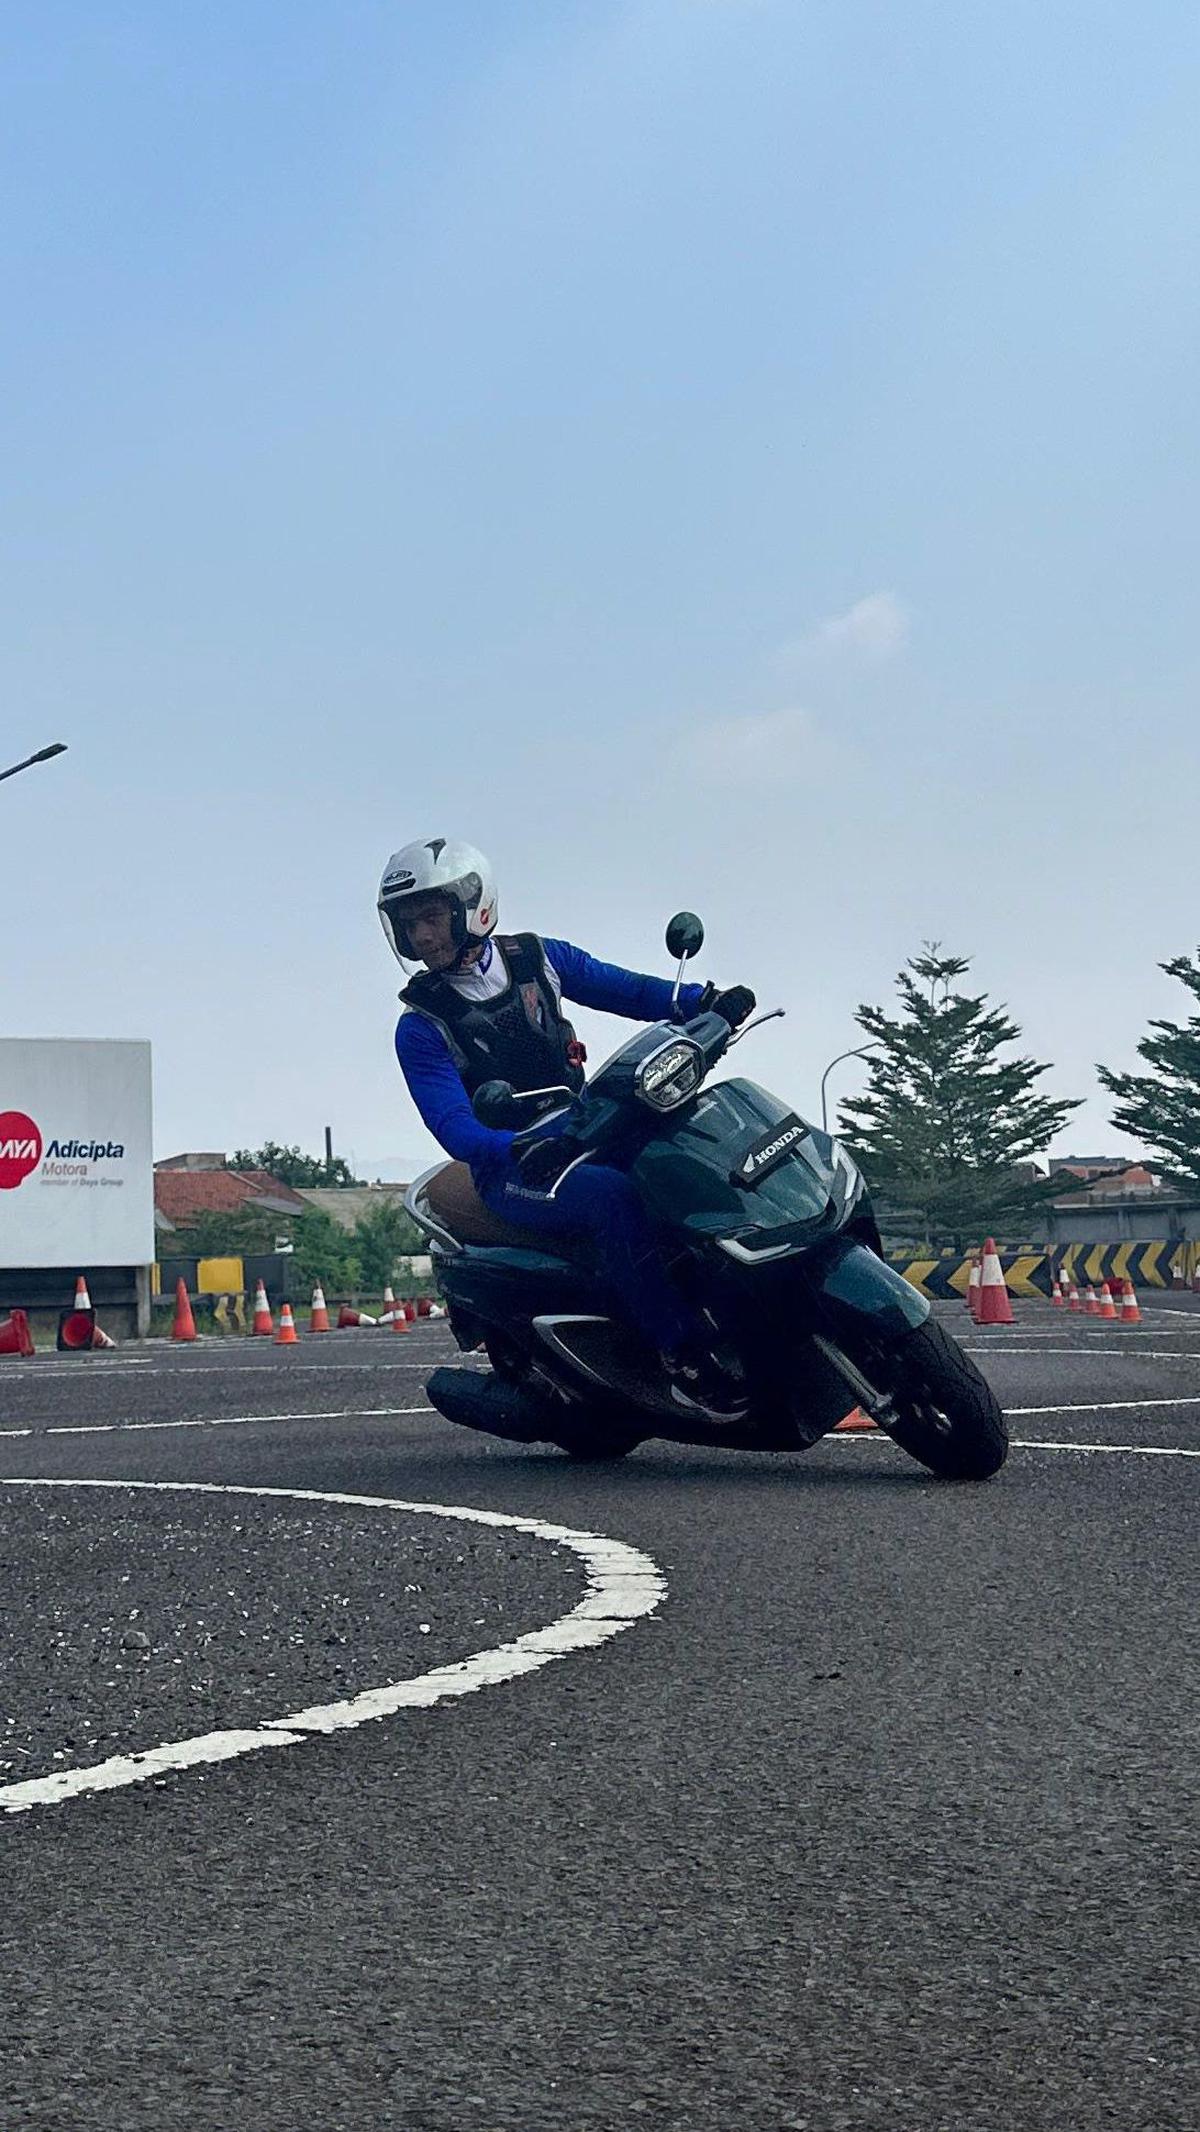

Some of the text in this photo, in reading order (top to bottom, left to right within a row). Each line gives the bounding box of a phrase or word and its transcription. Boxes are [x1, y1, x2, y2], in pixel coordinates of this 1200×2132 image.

[0, 1139, 37, 1159] AYA
[45, 1140, 124, 1162] Adicipta
[755, 1126, 804, 1164] HONDA
[42, 1163, 87, 1175] Motora
